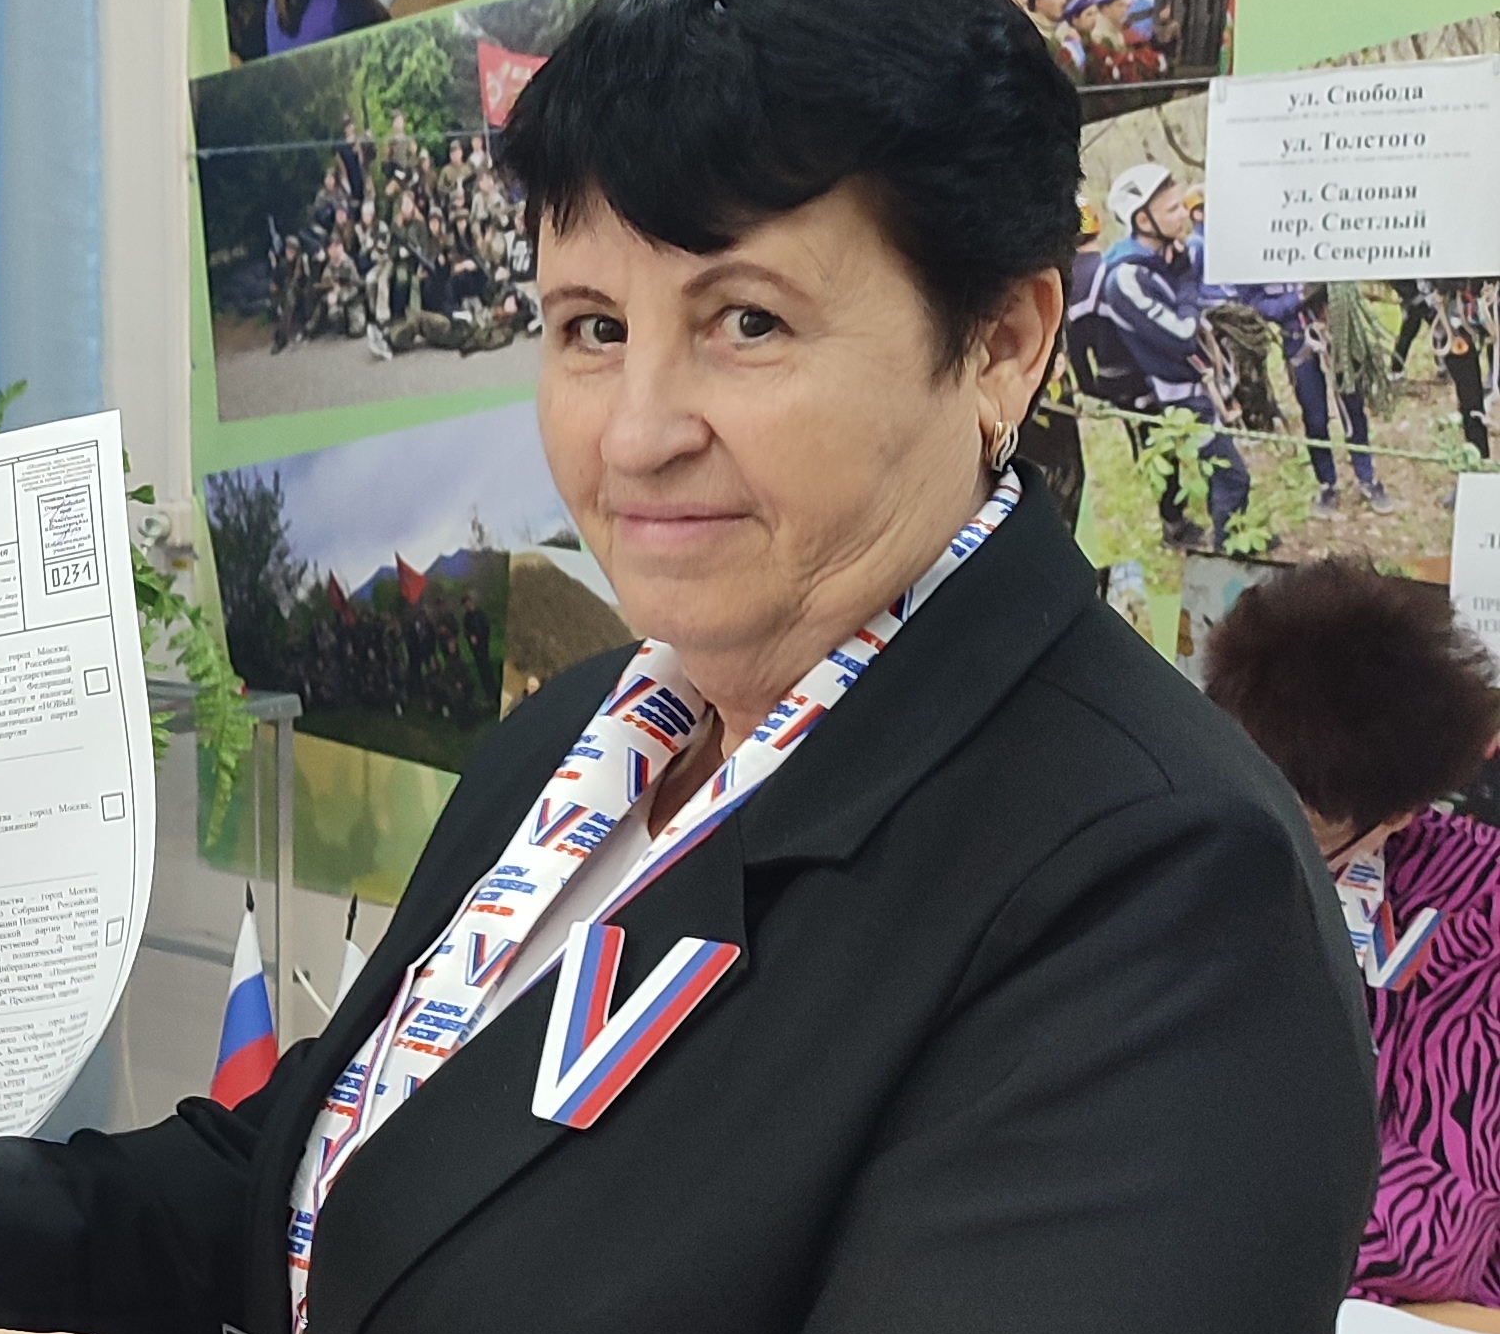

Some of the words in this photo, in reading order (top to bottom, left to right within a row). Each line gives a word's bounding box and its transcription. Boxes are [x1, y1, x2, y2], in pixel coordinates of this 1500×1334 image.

[1288, 94, 1319, 111] ул.
[1328, 83, 1423, 105] Свобода
[1280, 139, 1312, 157] ул.
[1320, 131, 1426, 150] Толстого
[1282, 189, 1313, 208] ул.
[1321, 182, 1418, 202] Садовая
[1270, 219, 1314, 237] пер.
[1322, 210, 1426, 232] Светлый
[1262, 248, 1305, 265] пер.
[1314, 240, 1431, 265] Северный
[52, 561, 91, 587] 0231
